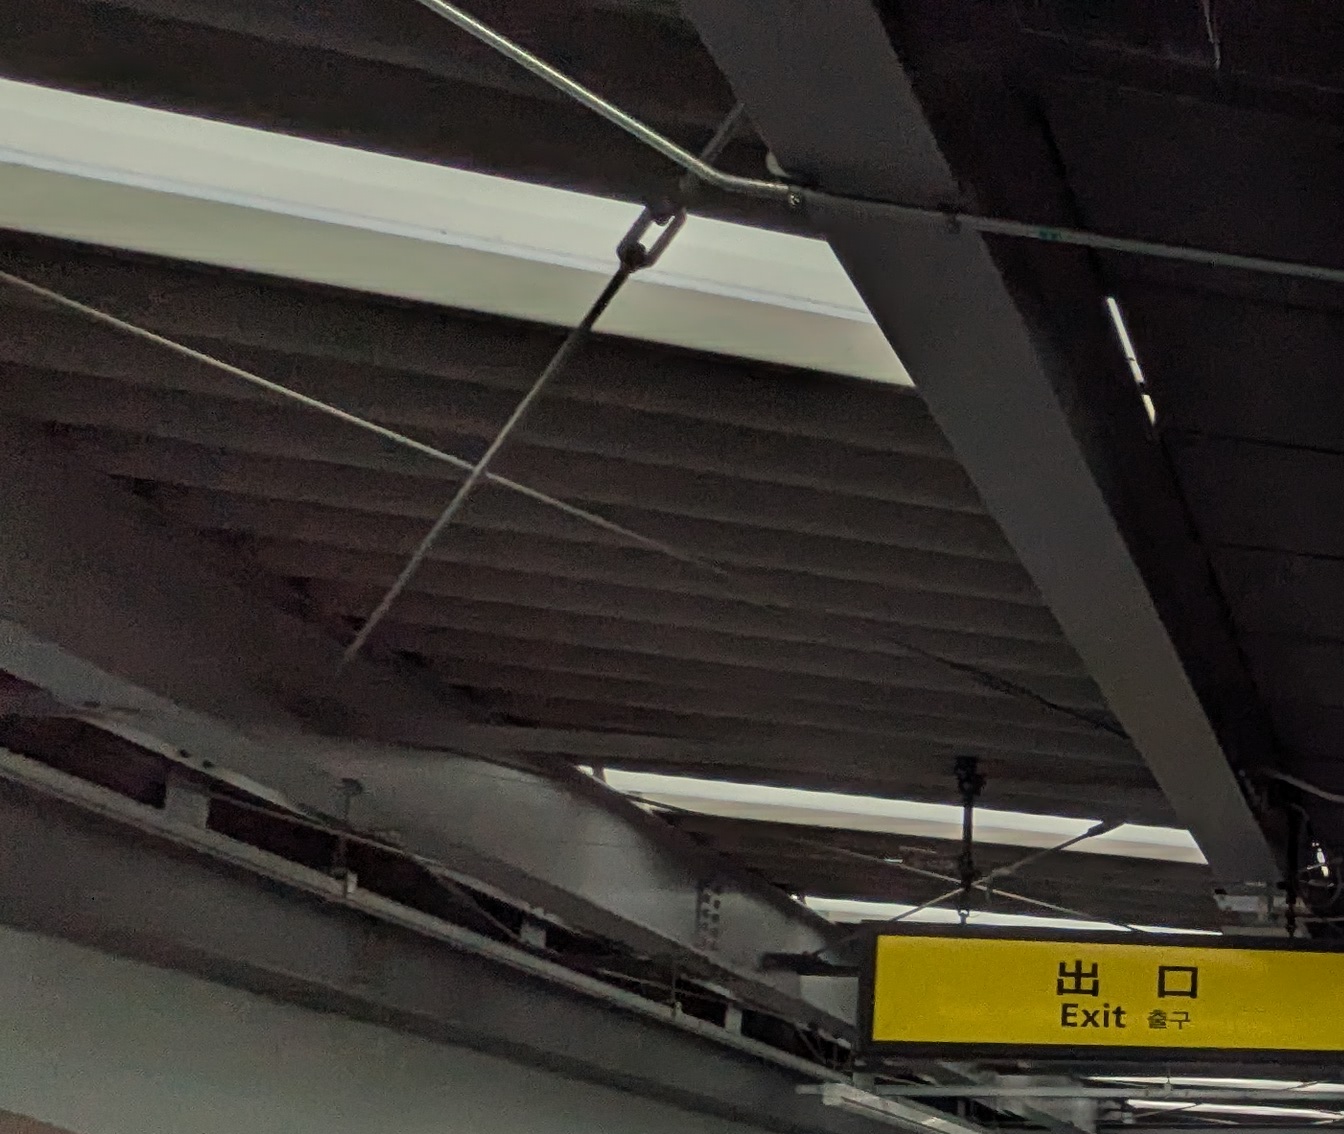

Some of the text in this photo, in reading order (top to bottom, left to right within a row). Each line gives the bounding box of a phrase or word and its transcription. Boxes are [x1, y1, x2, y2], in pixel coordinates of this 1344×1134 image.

[1056, 958, 1198, 999] 出口
[1061, 1003, 1127, 1029] Exit
[1147, 1009, 1191, 1030] 출구
